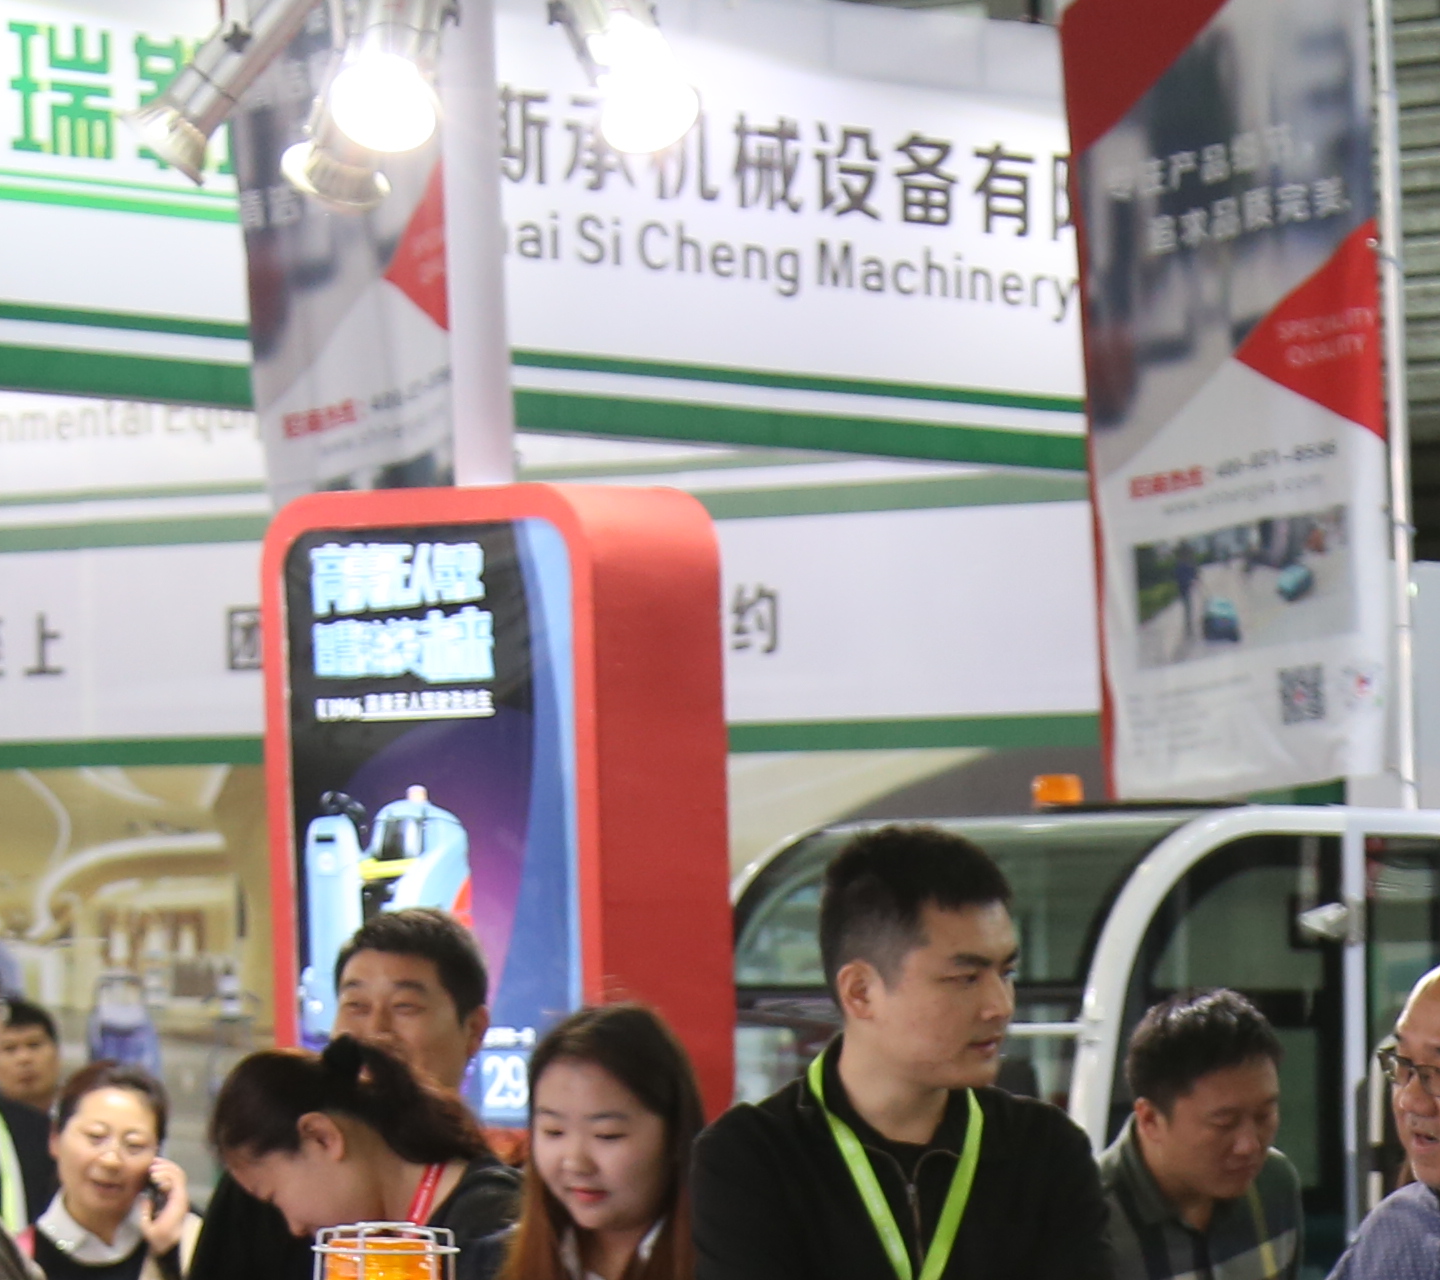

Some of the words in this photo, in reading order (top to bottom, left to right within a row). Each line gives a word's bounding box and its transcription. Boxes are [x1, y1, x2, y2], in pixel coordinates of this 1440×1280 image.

[576, 214, 622, 266] Si
[637, 219, 801, 298] Cheng
[816, 237, 1079, 323] Machinery
[731, 584, 780, 656] 约
